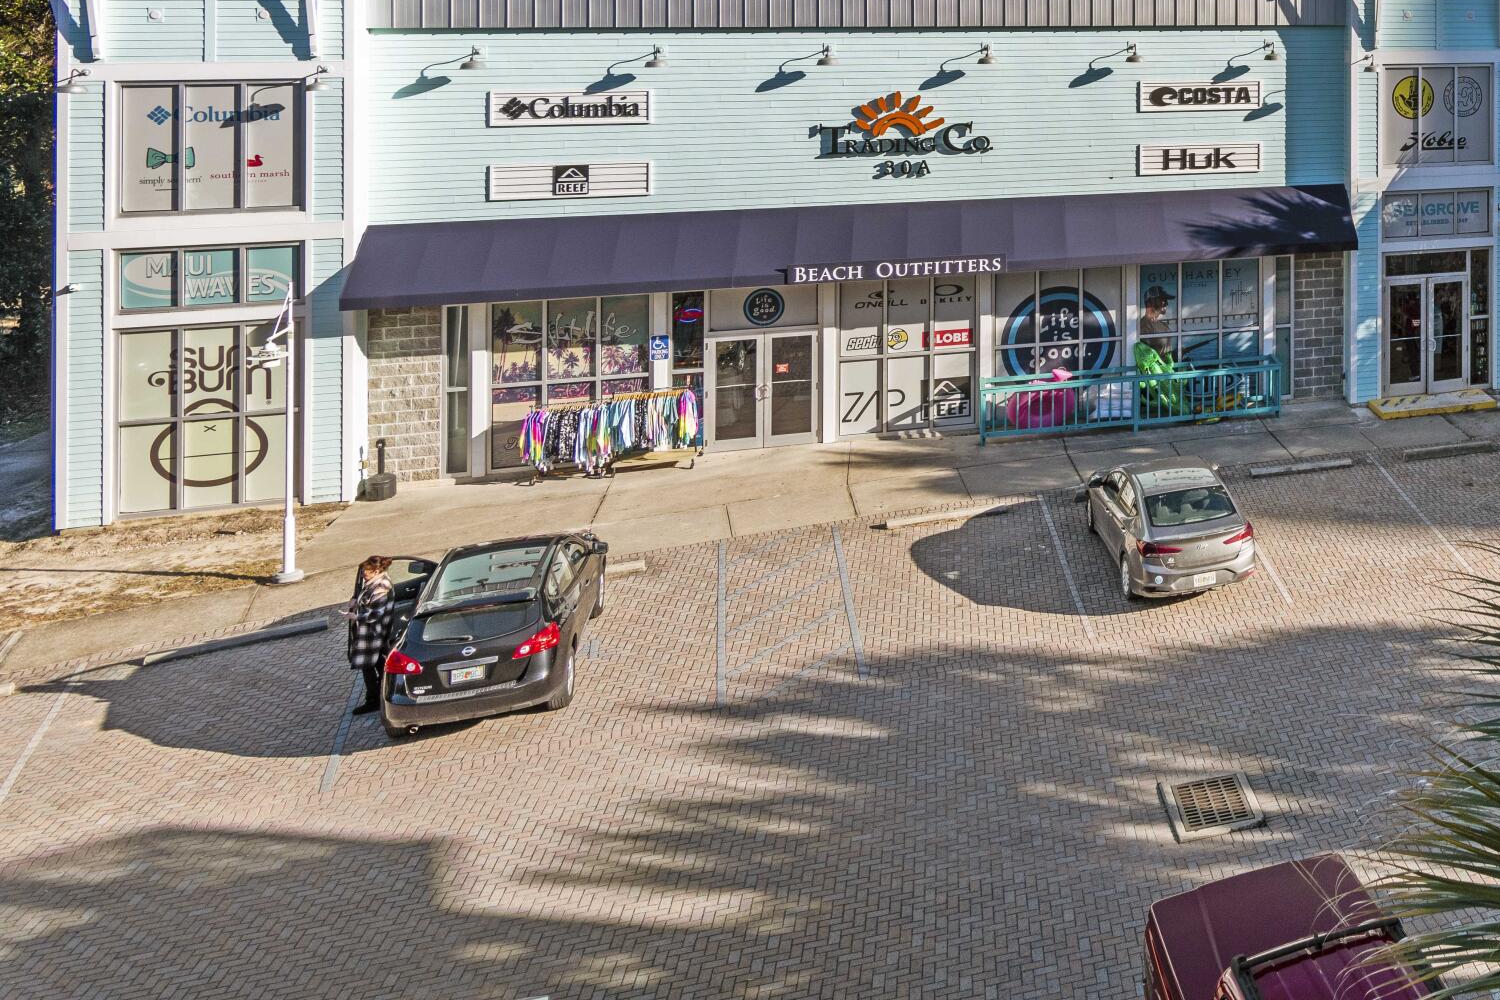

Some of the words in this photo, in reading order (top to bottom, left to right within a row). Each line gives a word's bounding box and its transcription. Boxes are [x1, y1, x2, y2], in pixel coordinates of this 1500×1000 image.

[1177, 87, 1251, 105] COSTA
[528, 96, 640, 119] Columbia
[210, 169, 256, 180] southn
[259, 169, 290, 178] marsh
[884, 159, 931, 175] 30A
[139, 176, 165, 187] simply
[167, 175, 200, 185] soern
[557, 183, 587, 193] REEF
[794, 265, 864, 284] BEACH
[876, 257, 1001, 279] OUTFITTERS
[1148, 271, 1177, 283] GUY
[1185, 267, 1241, 280] HAREY
[920, 296, 972, 305] OKLEY
[1039, 308, 1079, 333] Life
